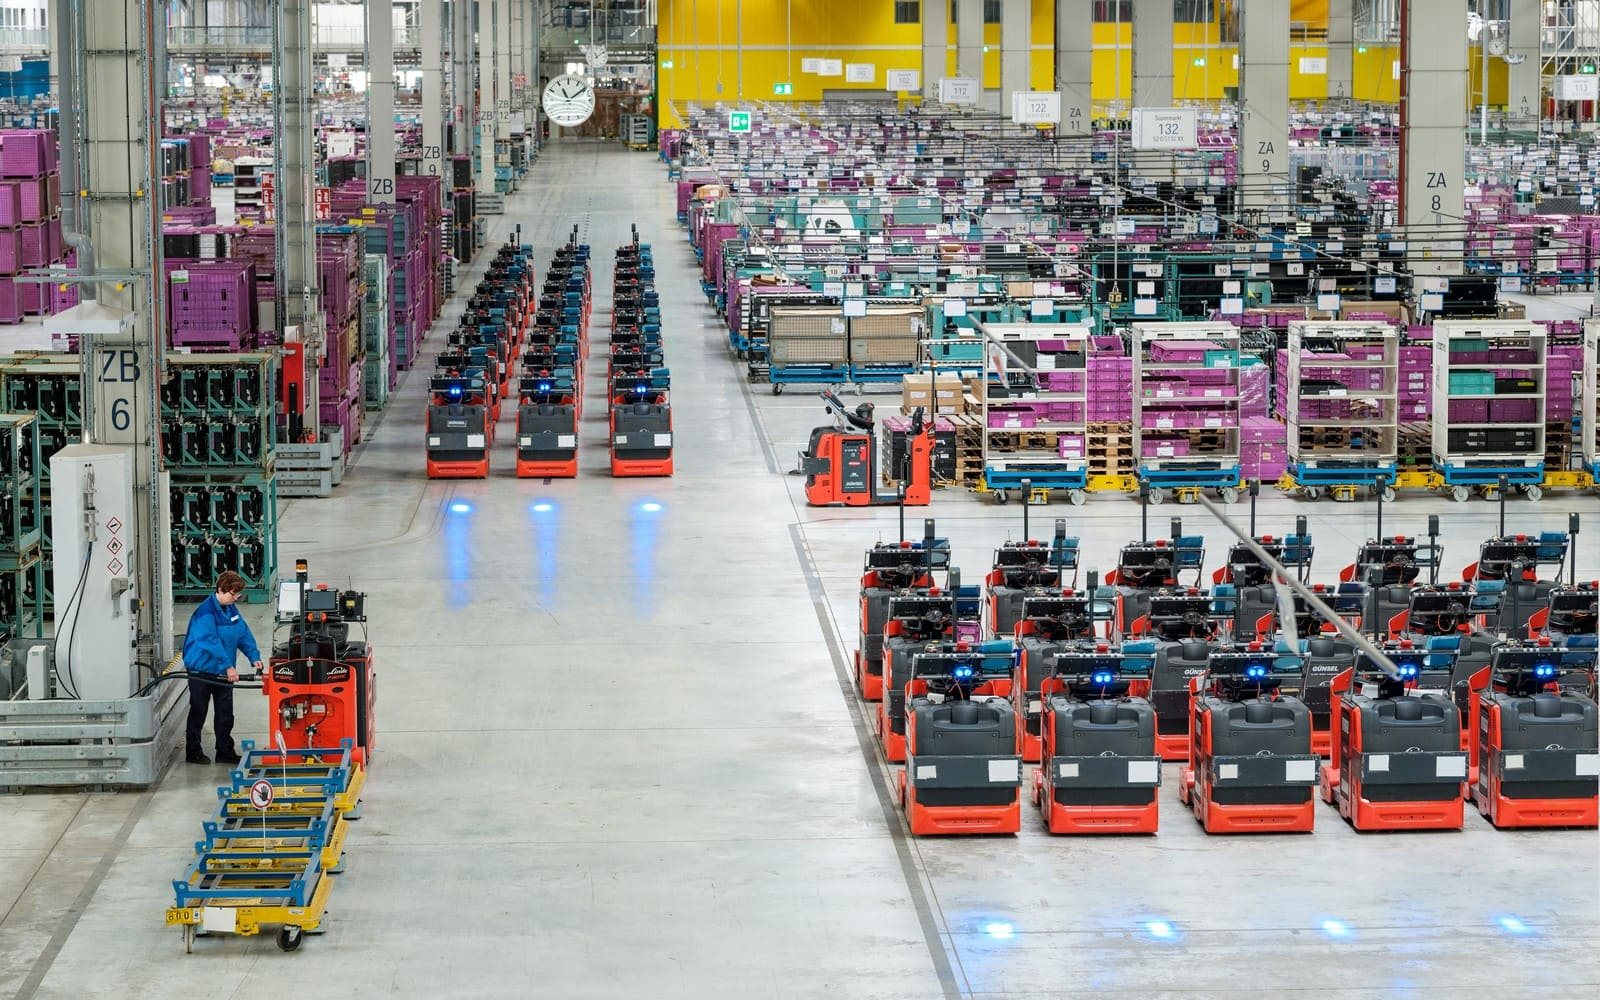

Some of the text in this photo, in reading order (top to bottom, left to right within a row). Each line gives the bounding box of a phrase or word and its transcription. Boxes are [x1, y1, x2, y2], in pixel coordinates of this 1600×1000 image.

[954, 88, 966, 96] 112
[1031, 104, 1047, 112] 122
[1070, 108, 1082, 118] ZA
[1520, 106, 1529, 114] 12
[481, 111, 492, 120] ZB
[482, 124, 492, 133] 11
[1071, 121, 1080, 130] 11
[1159, 123, 1178, 135] 132
[424, 146, 440, 159] ZB
[1258, 142, 1274, 154] ZA
[429, 164, 436, 176] 9
[1262, 160, 1270, 172] 9
[373, 178, 393, 194] ZB
[1426, 172, 1446, 188] ZA
[1432, 195, 1440, 210] 8
[98, 350, 140, 382] ZB
[112, 398, 130, 430] 6
[326, 666, 348, 675] Linde
